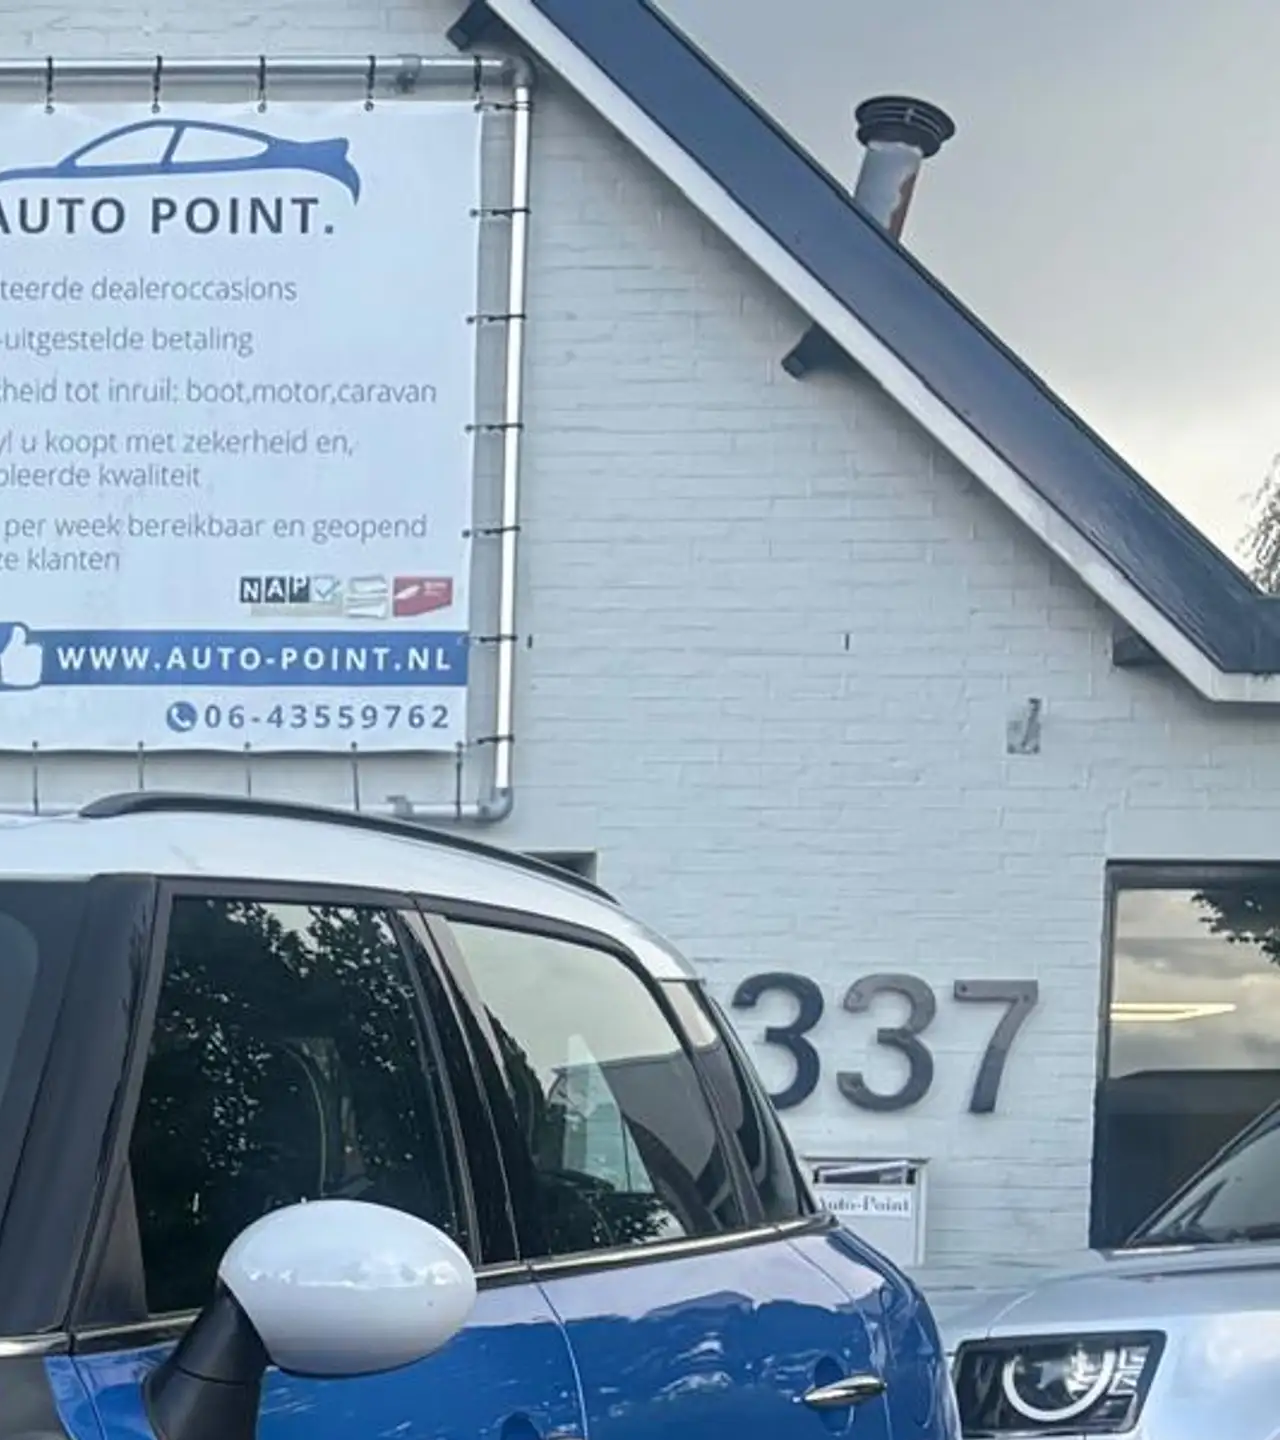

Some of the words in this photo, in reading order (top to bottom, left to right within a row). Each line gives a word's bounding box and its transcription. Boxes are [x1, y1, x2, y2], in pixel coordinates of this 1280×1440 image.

[150, 196, 336, 236] POINT.
[91, 276, 298, 303] dealeroccasions
[152, 328, 254, 356] betaling
[65, 382, 99, 404] tot
[107, 379, 179, 404] inruil:
[186, 380, 437, 408] boot,motor,caravan
[21, 436, 37, 455] u
[45, 431, 118, 461] koopt
[125, 434, 175, 455] met
[182, 430, 307, 455] zekerheid
[315, 436, 354, 460] en,
[98, 463, 201, 488] kwaliteit
[3, 518, 45, 544] per
[54, 512, 121, 538] week
[127, 512, 266, 538] bereikbaar
[274, 517, 304, 538] en
[312, 513, 427, 544] geopend
[26, 547, 120, 571] klanten
[242, 576, 308, 601] NAP
[57, 644, 452, 672] WWW.AUTO-POINT.NL
[204, 703, 451, 731] 06-43559762
[732, 972, 1039, 1114] 337
